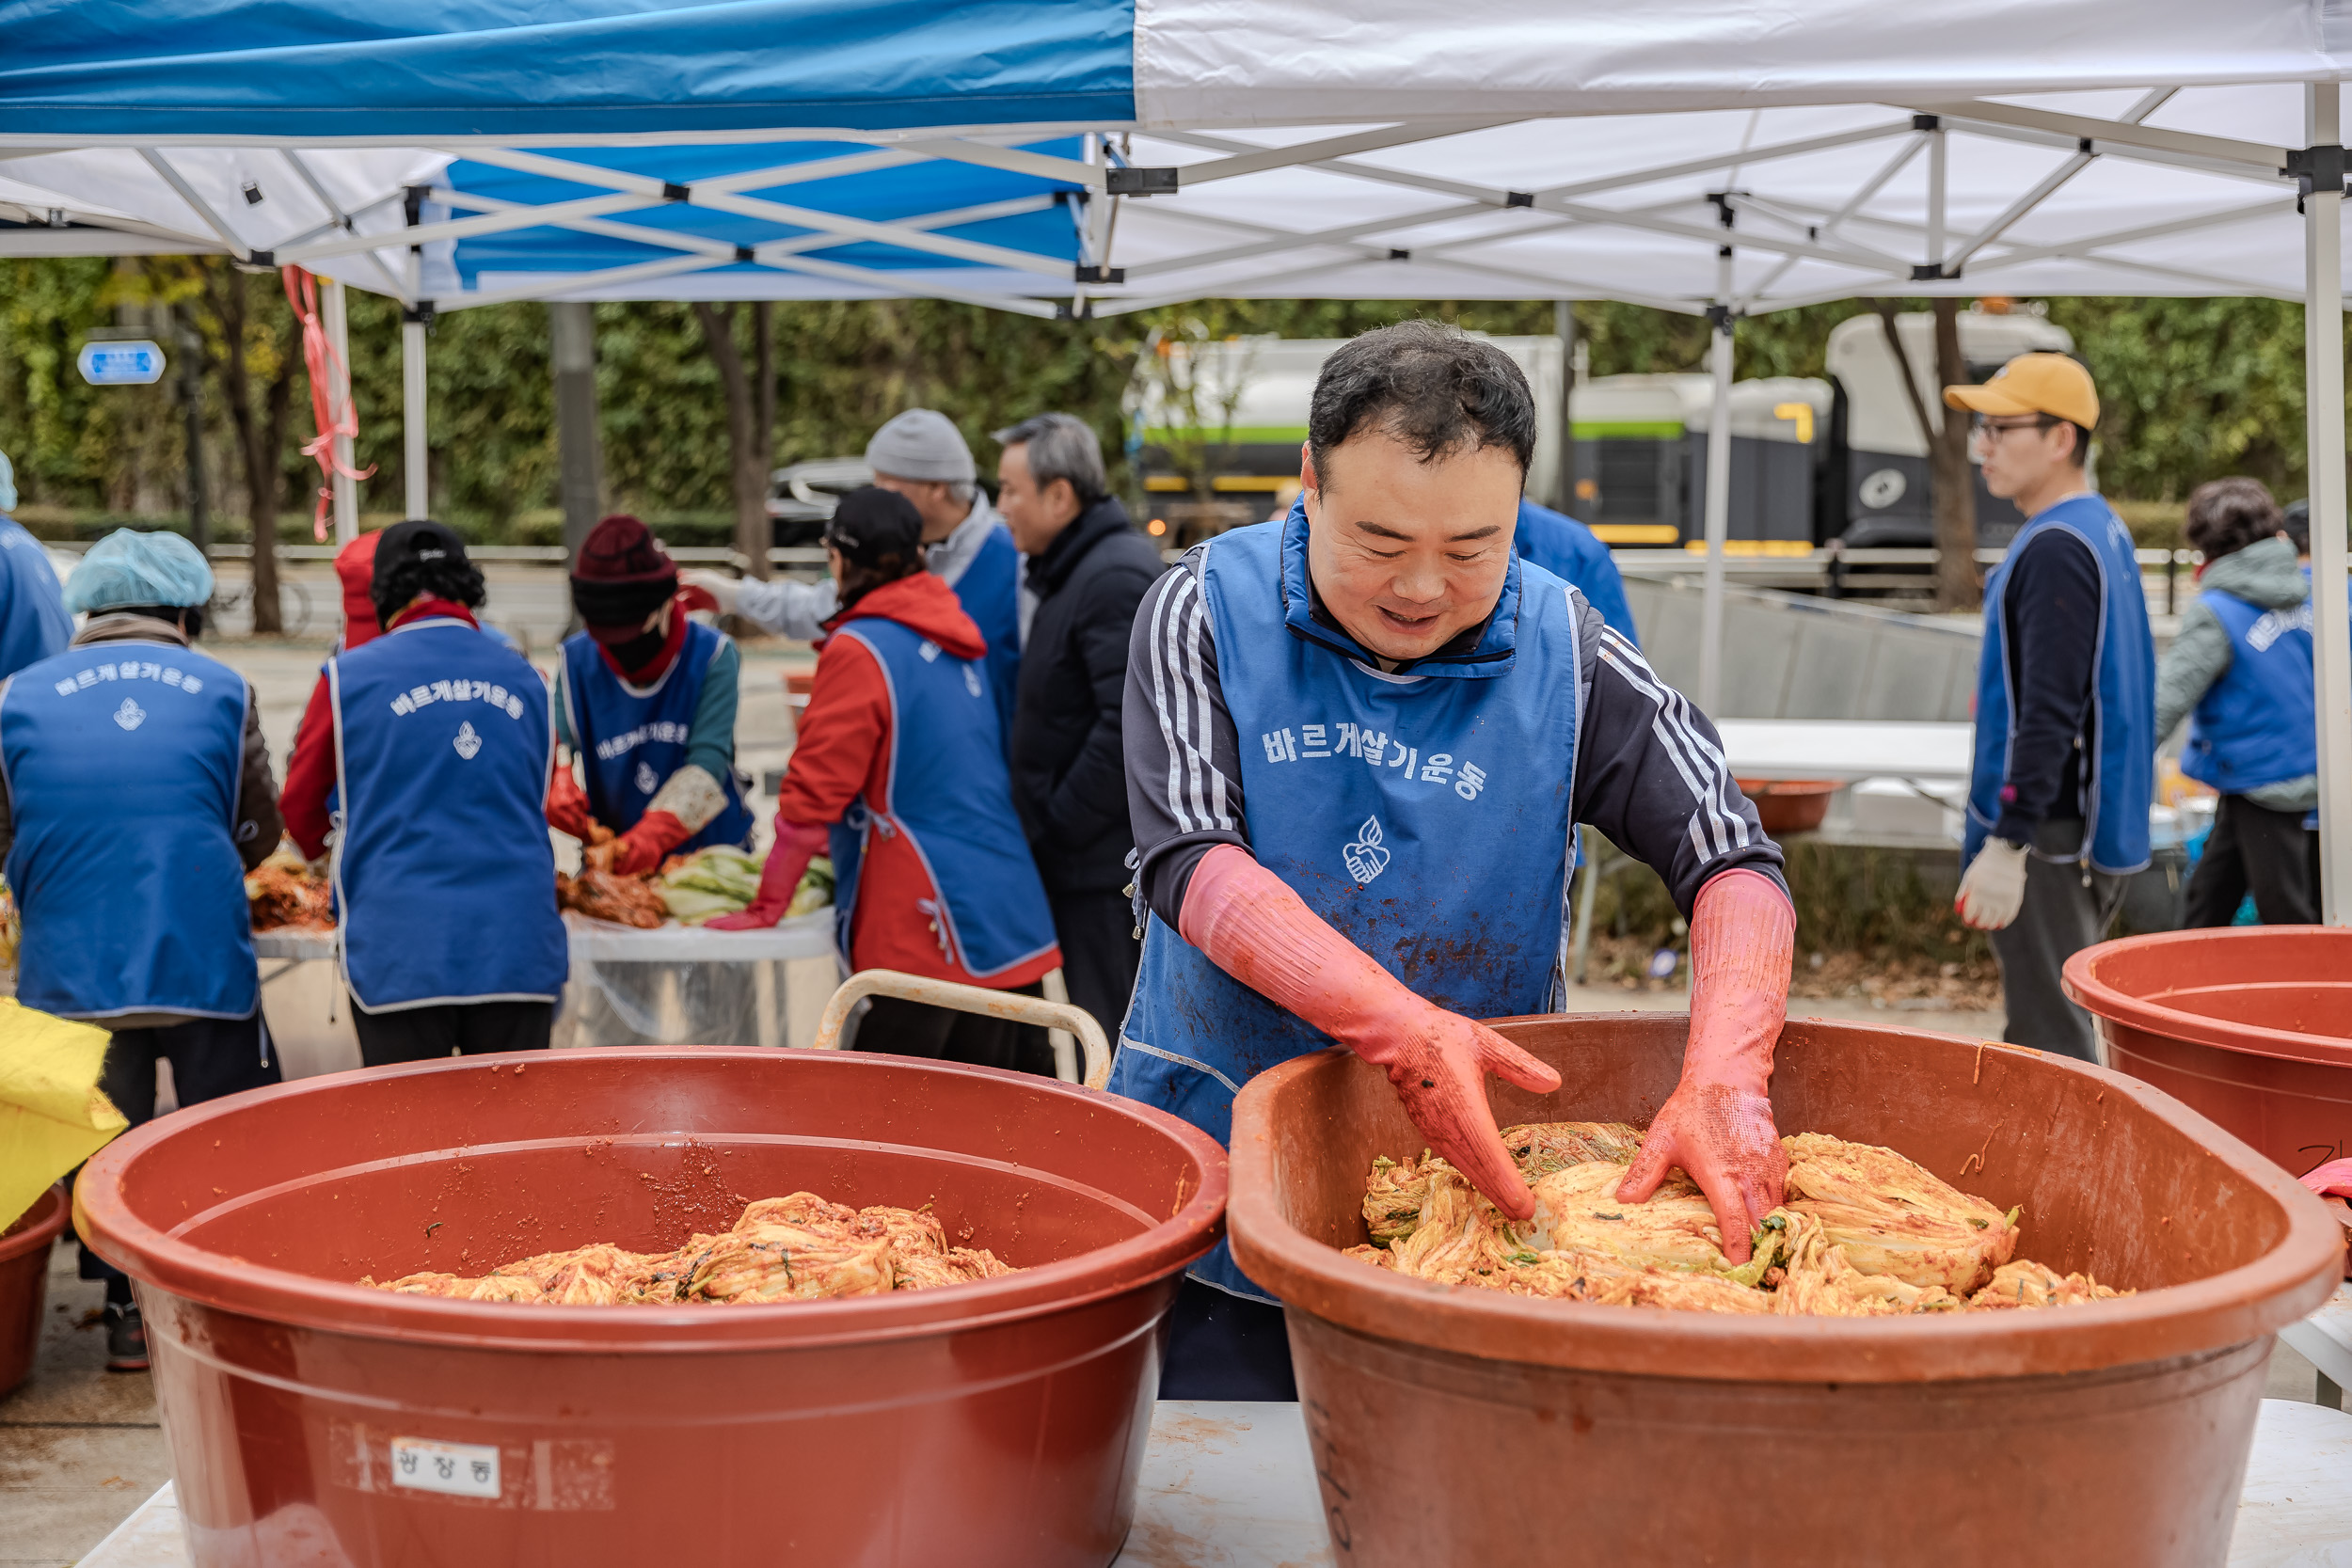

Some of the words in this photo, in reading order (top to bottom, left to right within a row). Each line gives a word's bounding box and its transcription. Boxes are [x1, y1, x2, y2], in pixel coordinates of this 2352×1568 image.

[54, 660, 204, 697] 바르게살기운동
[389, 678, 524, 721] 바르게살기운동
[1262, 722, 1487, 801] 바르게살기운동
